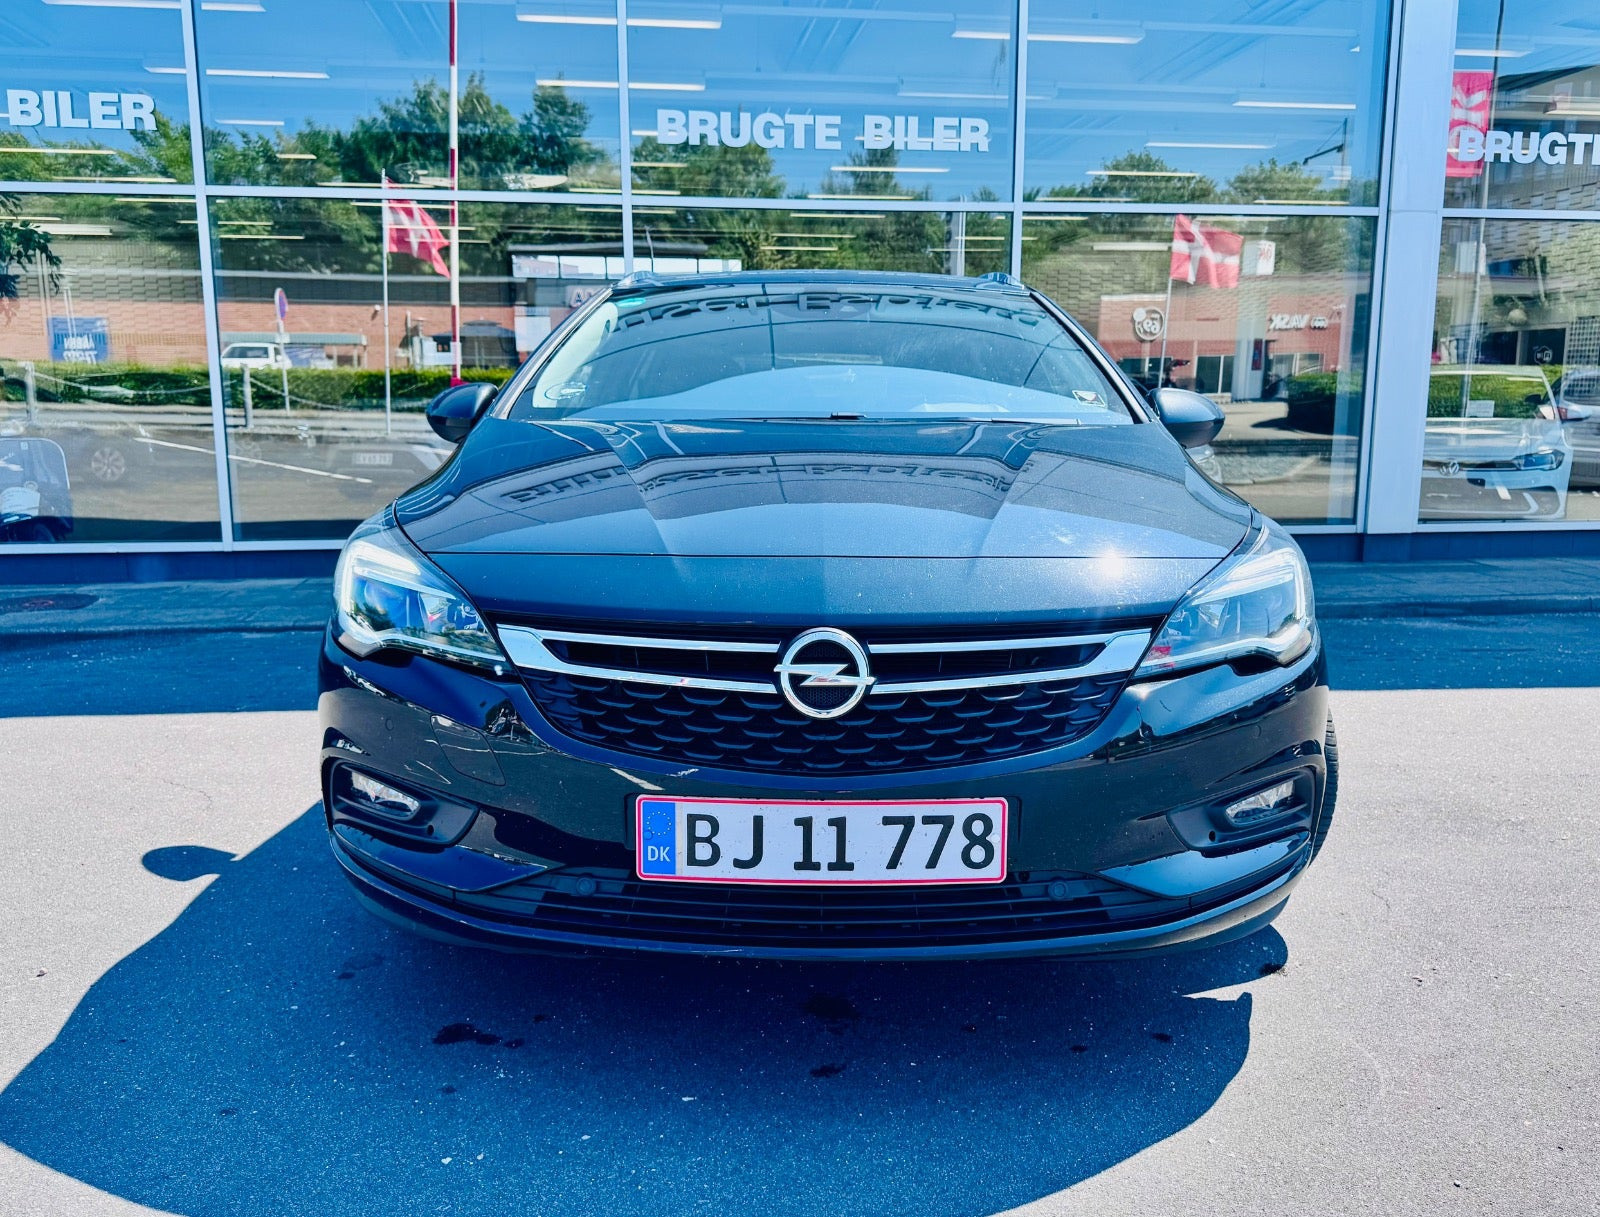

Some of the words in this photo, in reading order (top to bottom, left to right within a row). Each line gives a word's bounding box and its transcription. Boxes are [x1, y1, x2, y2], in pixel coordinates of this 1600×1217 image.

[6, 89, 158, 131] BILER
[656, 109, 842, 150] BRUGTE
[863, 114, 989, 152] BILER
[647, 845, 671, 863] DK
[686, 813, 765, 870] BJ
[793, 815, 855, 872] 11
[881, 812, 995, 871] 778
